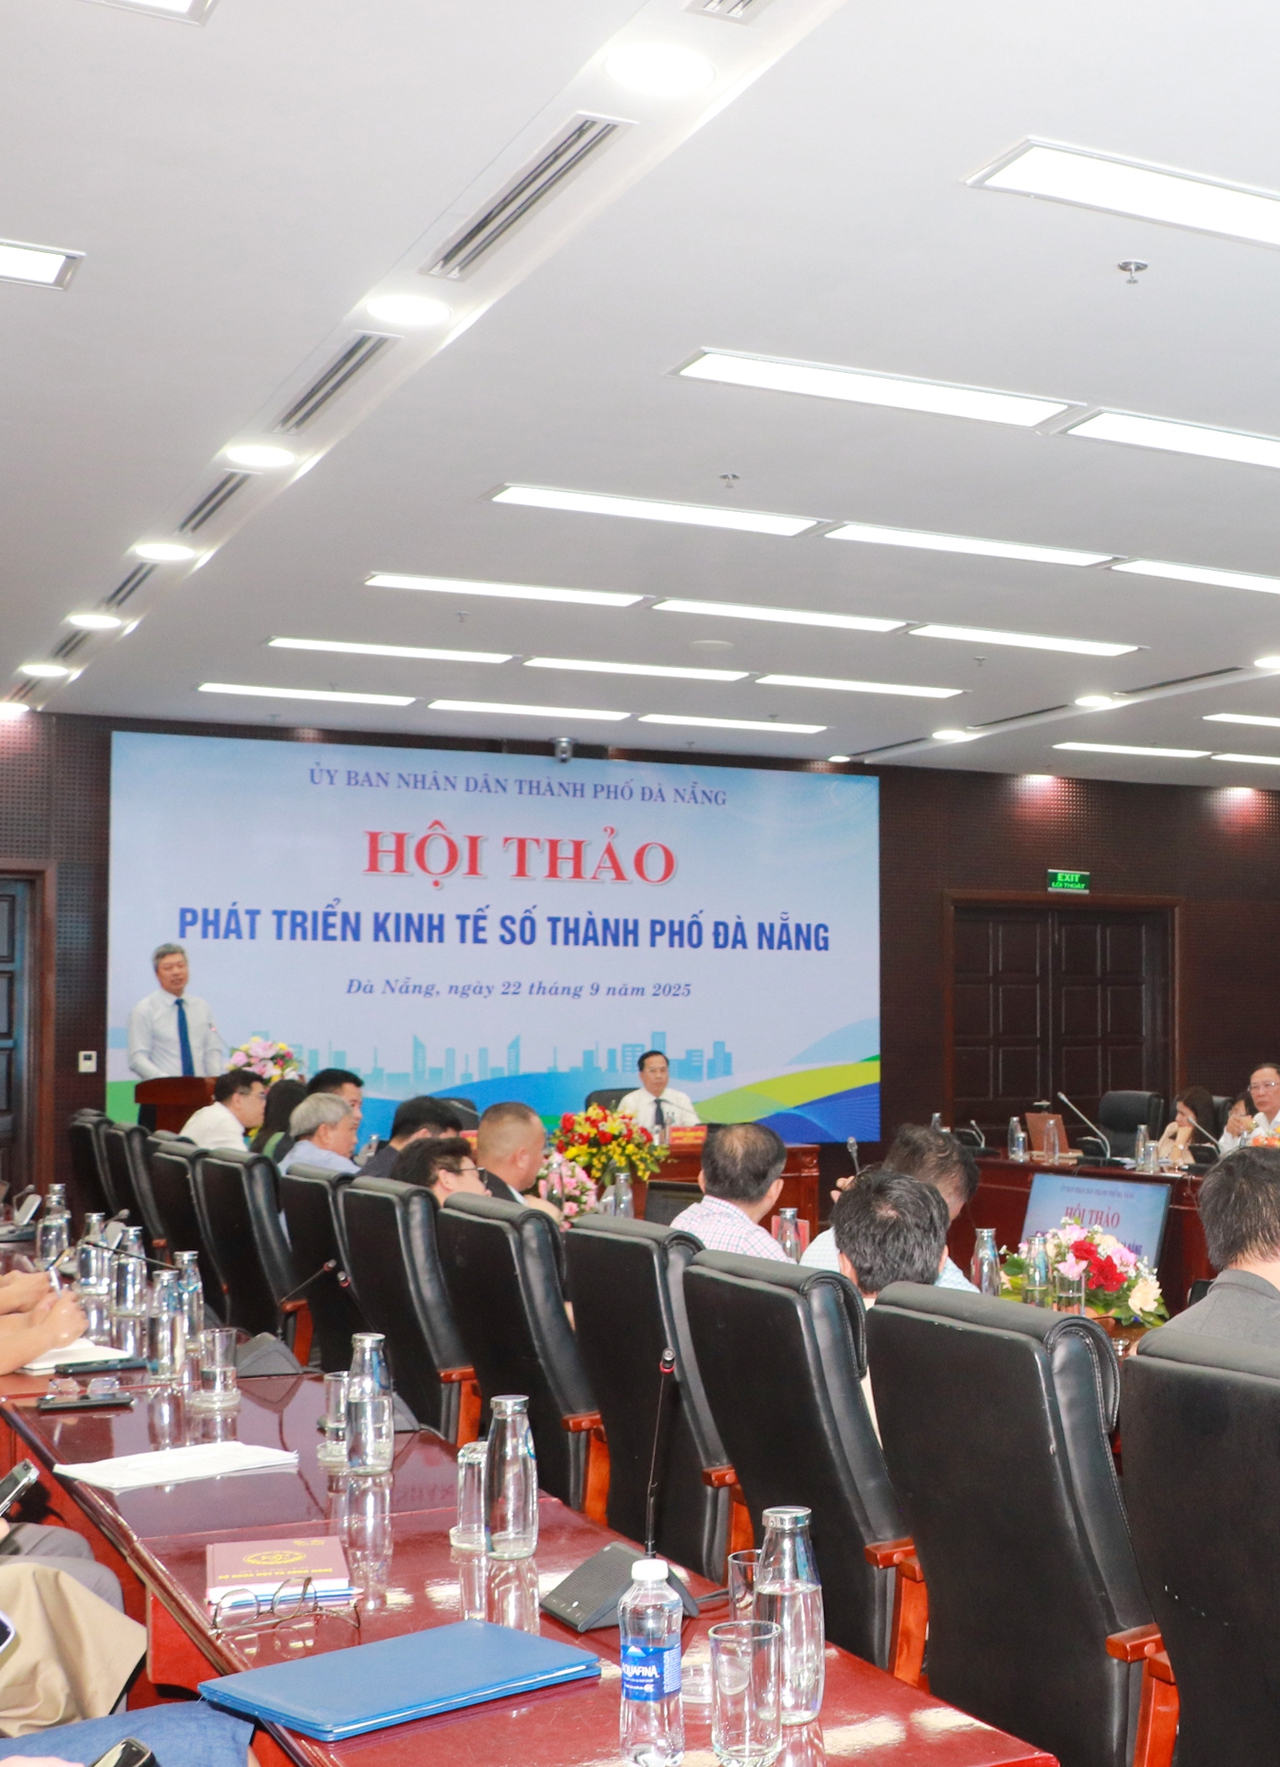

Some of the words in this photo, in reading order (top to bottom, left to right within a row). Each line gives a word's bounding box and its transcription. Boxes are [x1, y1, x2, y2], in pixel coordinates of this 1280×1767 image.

[308, 761, 338, 785] ỦY
[346, 770, 390, 788] BAN
[397, 770, 458, 791] NHÂN
[465, 772, 509, 793] DÂN
[514, 776, 586, 798] THÀNH
[592, 778, 634, 800] PHỐ
[641, 782, 666, 802] ĐÀ
[673, 781, 727, 805] NẴNG
[362, 819, 485, 888] HỘI
[502, 825, 677, 884] THẢO
[1057, 873, 1080, 882] EXIT
[178, 901, 261, 940] PHÁT
[272, 898, 361, 942] TRIỂN
[373, 911, 445, 944] KINH
[455, 904, 490, 944] TẾ
[499, 905, 537, 945] SỐ
[547, 911, 639, 948] THÀNH
[649, 909, 704, 949] PHỐ
[712, 915, 748, 950] ĐÀ
[757, 912, 830, 951] NẴNG
[345, 978, 374, 994] Đà
[382, 976, 440, 998] Nẵng,
[448, 980, 495, 999] ngày
[500, 981, 522, 995] 22
[528, 980, 584, 999] tháng
[589, 982, 600, 996] 9
[606, 983, 646, 997] năm
[652, 983, 692, 997] 2025
[1088, 1206, 1120, 1228] THẢO
